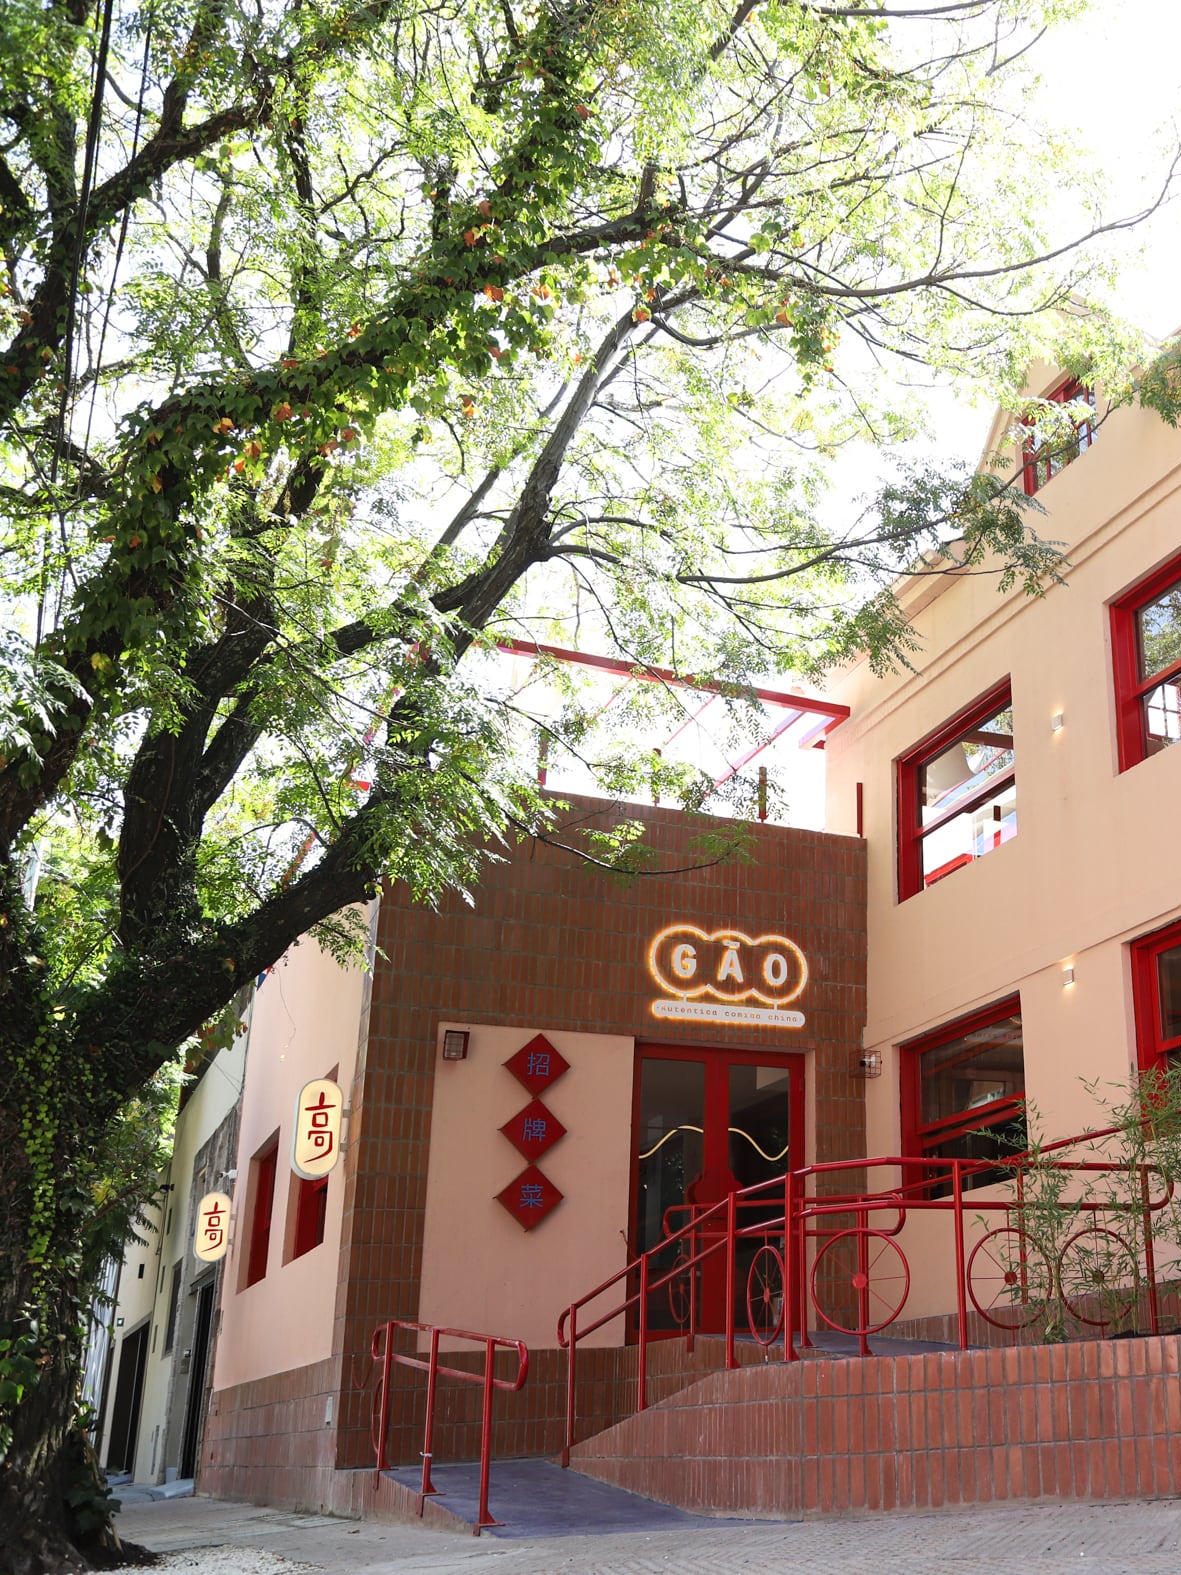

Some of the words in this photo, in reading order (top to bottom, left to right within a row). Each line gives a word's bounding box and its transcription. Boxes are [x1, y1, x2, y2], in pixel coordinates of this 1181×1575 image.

[304, 1091, 336, 1163] 高
[519, 1052, 550, 1208] 招牌菜
[201, 1201, 226, 1252] 高
